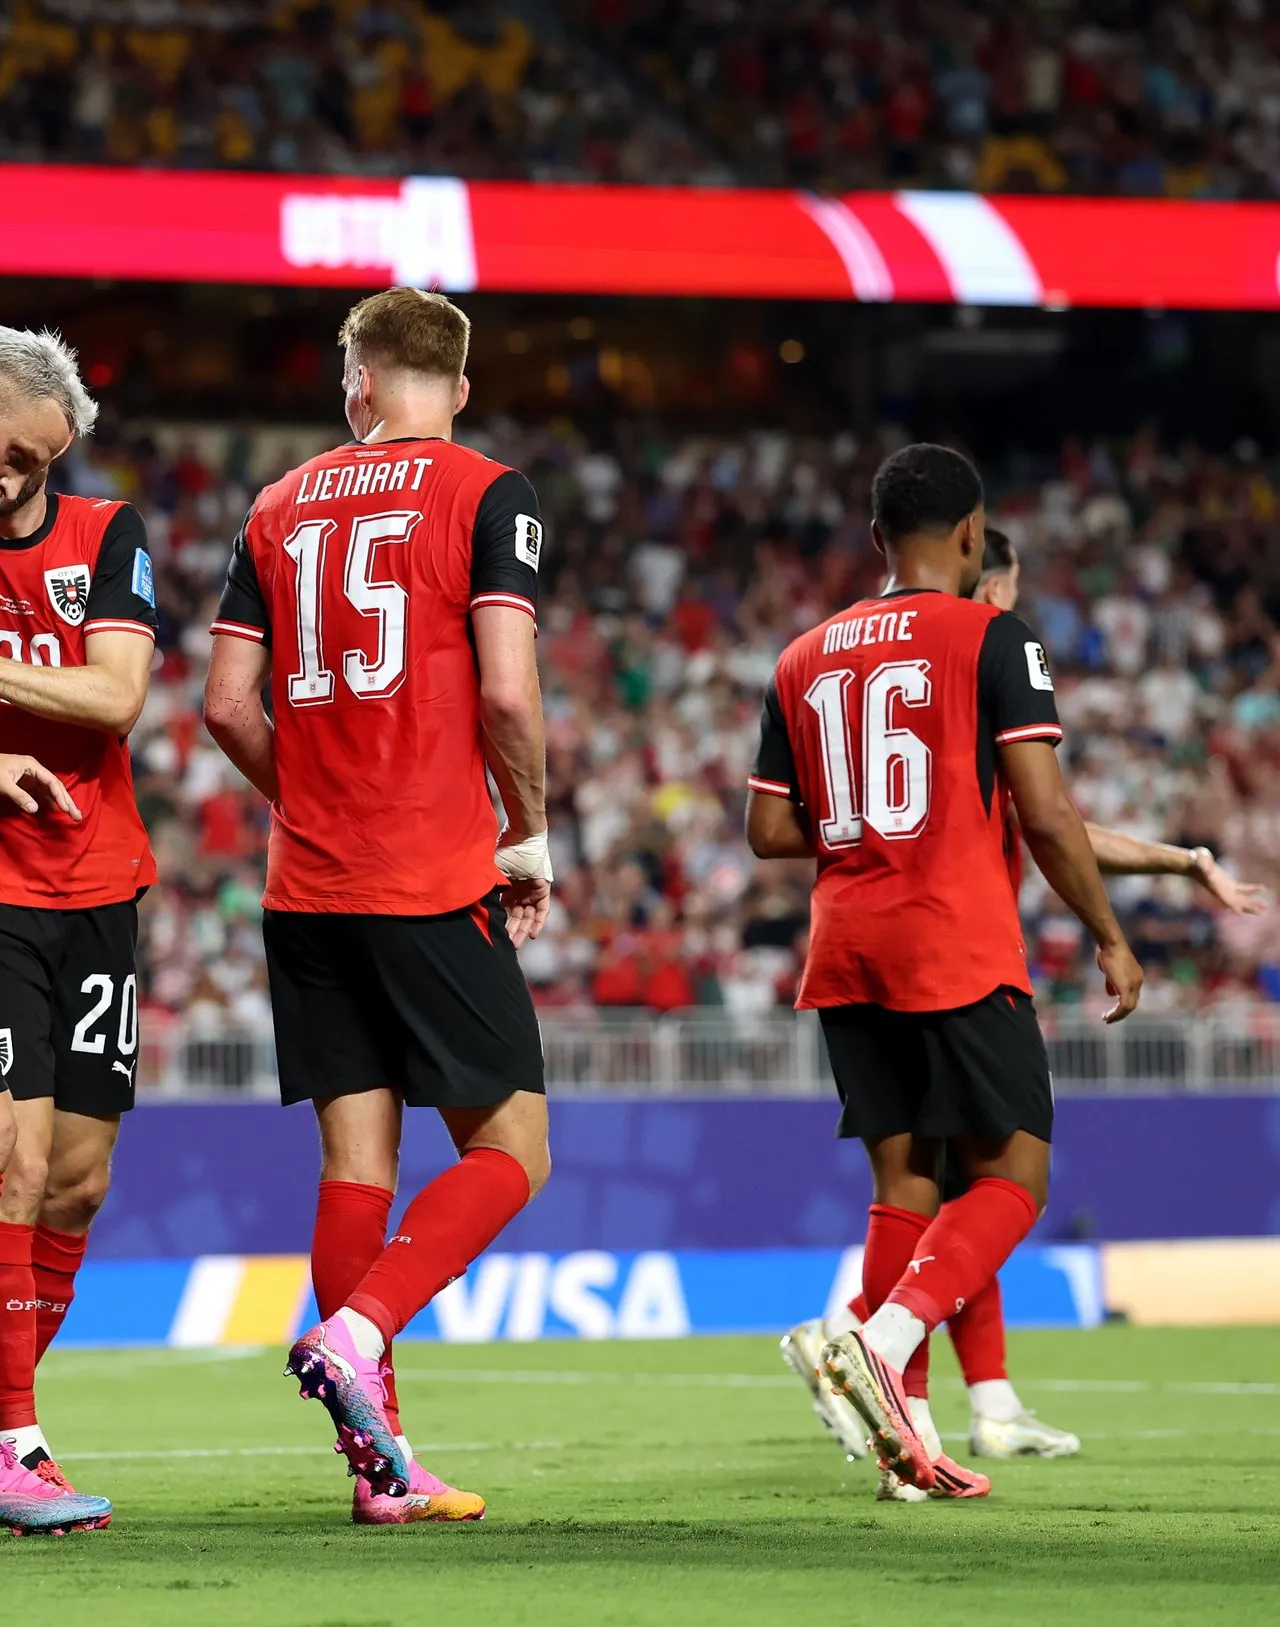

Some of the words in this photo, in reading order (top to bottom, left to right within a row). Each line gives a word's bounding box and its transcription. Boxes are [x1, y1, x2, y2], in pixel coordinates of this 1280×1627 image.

[296, 458, 434, 505] LIENHART
[283, 510, 424, 708] 15
[823, 610, 918, 655] MWENE
[803, 659, 932, 851] 16
[71, 973, 137, 1055] 20
[432, 1250, 692, 1342] VISA
